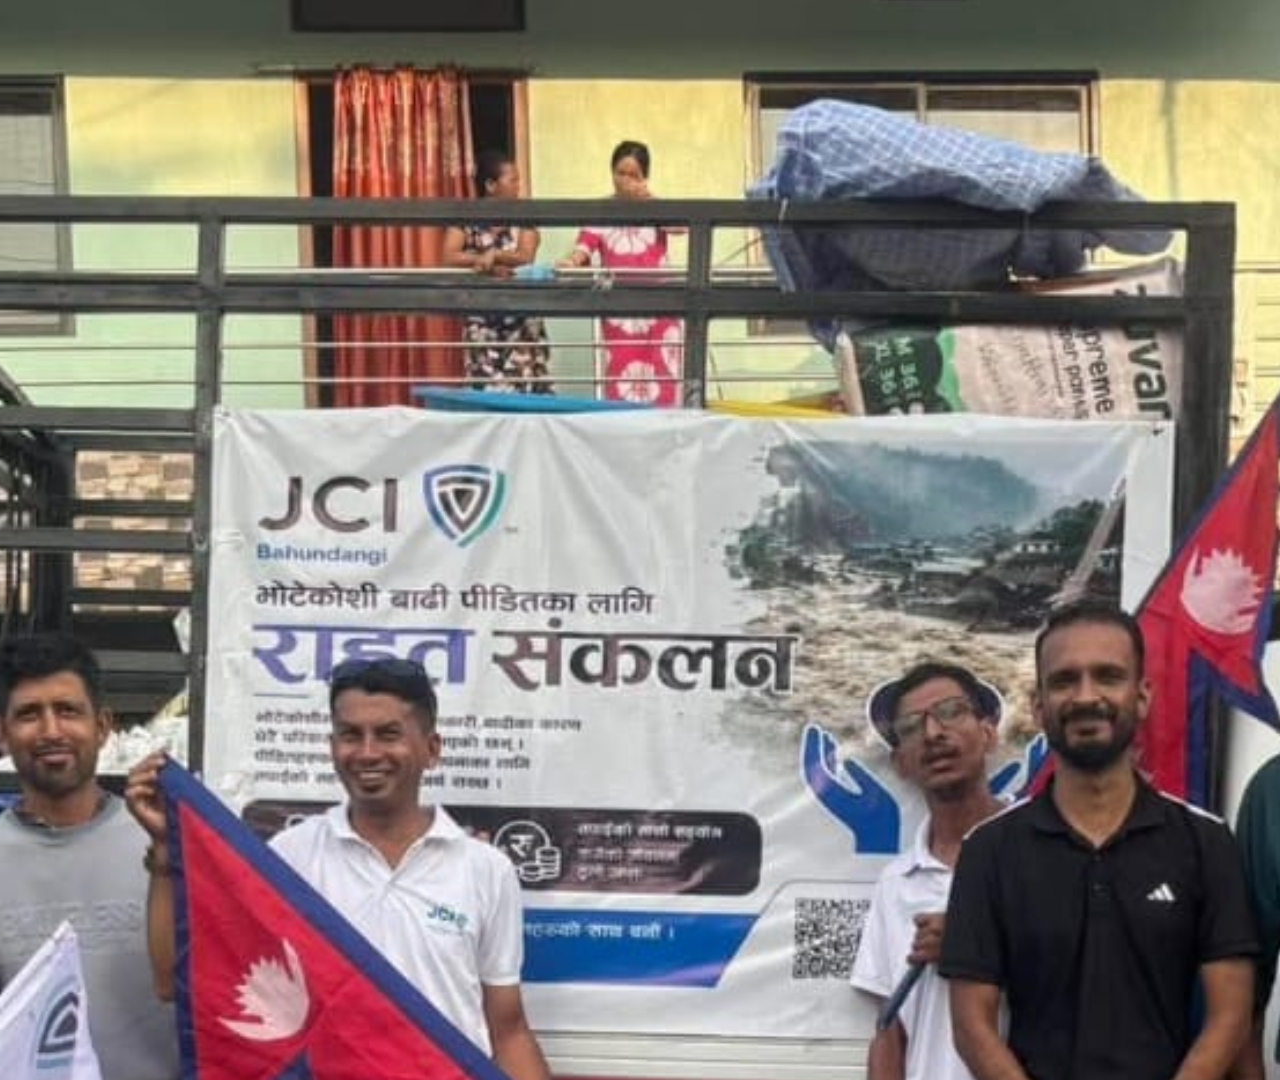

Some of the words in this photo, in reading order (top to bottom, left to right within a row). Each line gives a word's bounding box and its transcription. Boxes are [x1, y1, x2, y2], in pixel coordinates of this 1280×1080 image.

[258, 475, 398, 533] JCI
[256, 543, 388, 566] Bahundangi
[256, 580, 378, 610] भोटेकोशी
[390, 582, 448, 611] बाढी
[460, 584, 576, 614] पीडितका
[587, 584, 655, 615] लागि
[492, 617, 799, 692] संकलन
